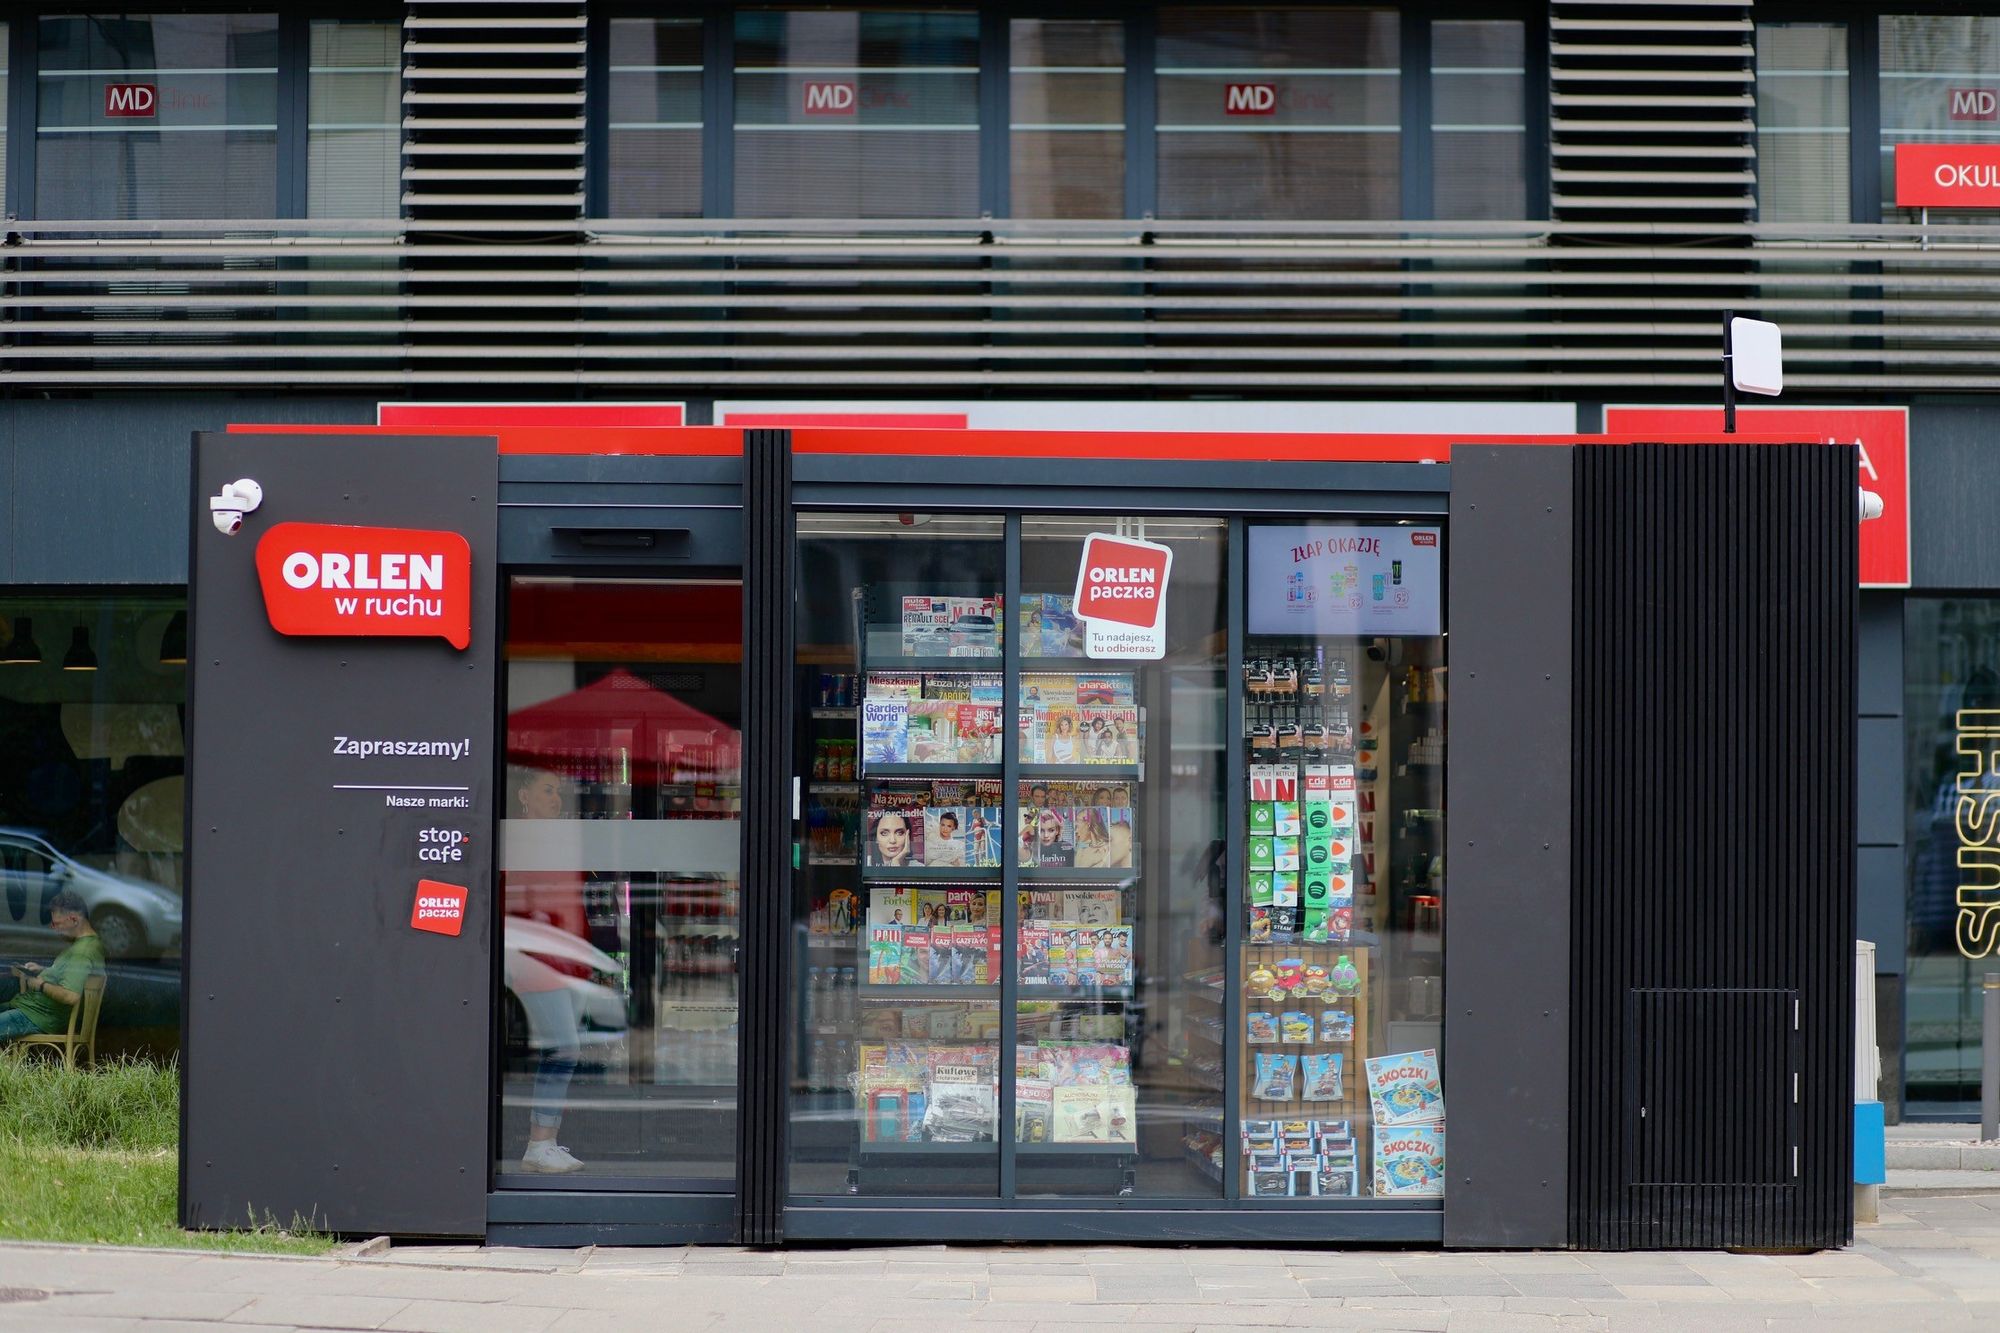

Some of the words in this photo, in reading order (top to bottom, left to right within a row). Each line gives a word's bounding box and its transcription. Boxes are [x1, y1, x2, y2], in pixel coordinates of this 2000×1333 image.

[109, 87, 153, 111] MD
[807, 85, 853, 109] MD
[1228, 86, 1274, 110] MD
[1952, 91, 1996, 115] MD
[1290, 541, 1323, 563] ZŁAP
[1328, 537, 1381, 557] OKAZJĘ
[282, 552, 443, 590] ORLEN
[1089, 567, 1155, 583] ORLEN
[1090, 586, 1155, 601] paczka
[335, 598, 358, 615] w
[366, 594, 442, 616] ruchu
[903, 615, 932, 624] RENAULT
[1093, 633, 1104, 642] Tu
[1106, 632, 1154, 643] nadajesz,
[1094, 645, 1104, 653] tu
[1106, 644, 1156, 653] odbierasz
[868, 676, 920, 686] Mieszkanie
[866, 712, 898, 722] World
[333, 736, 470, 760] Zapraszamy!
[386, 796, 425, 807] Nasze
[429, 797, 469, 808] marki:
[1956, 709, 2000, 960] SUSHI
[419, 846, 462, 863] cafe
[419, 898, 460, 908] ORLEN
[948, 891, 975, 904] party
[419, 909, 460, 919] paczka
[1377, 1066, 1429, 1087] SKOCZKI
[1383, 1140, 1435, 1157] SKOCZKI
